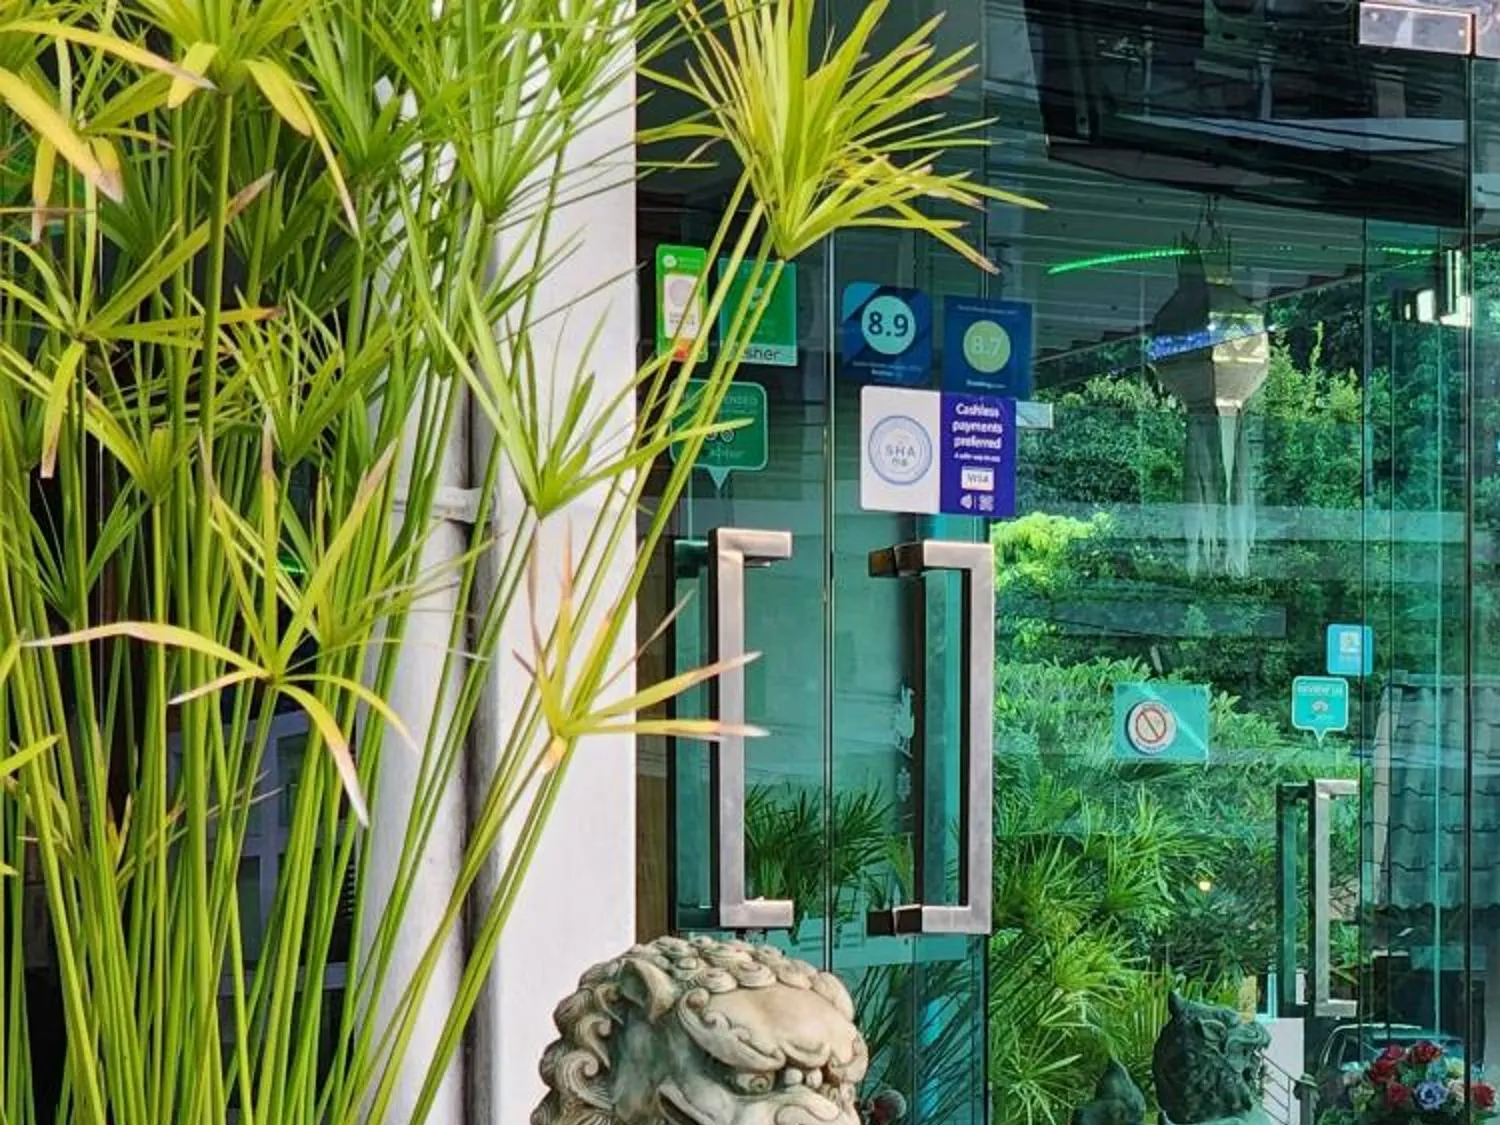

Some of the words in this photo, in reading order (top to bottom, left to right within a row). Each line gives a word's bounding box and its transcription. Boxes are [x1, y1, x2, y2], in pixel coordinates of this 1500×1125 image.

[868, 311, 909, 338] 8.9
[972, 334, 1001, 358] 8.7
[955, 403, 1000, 418] Cashless
[952, 420, 1003, 434] payments
[953, 435, 1002, 449] preferred
[885, 443, 916, 457] SHA
